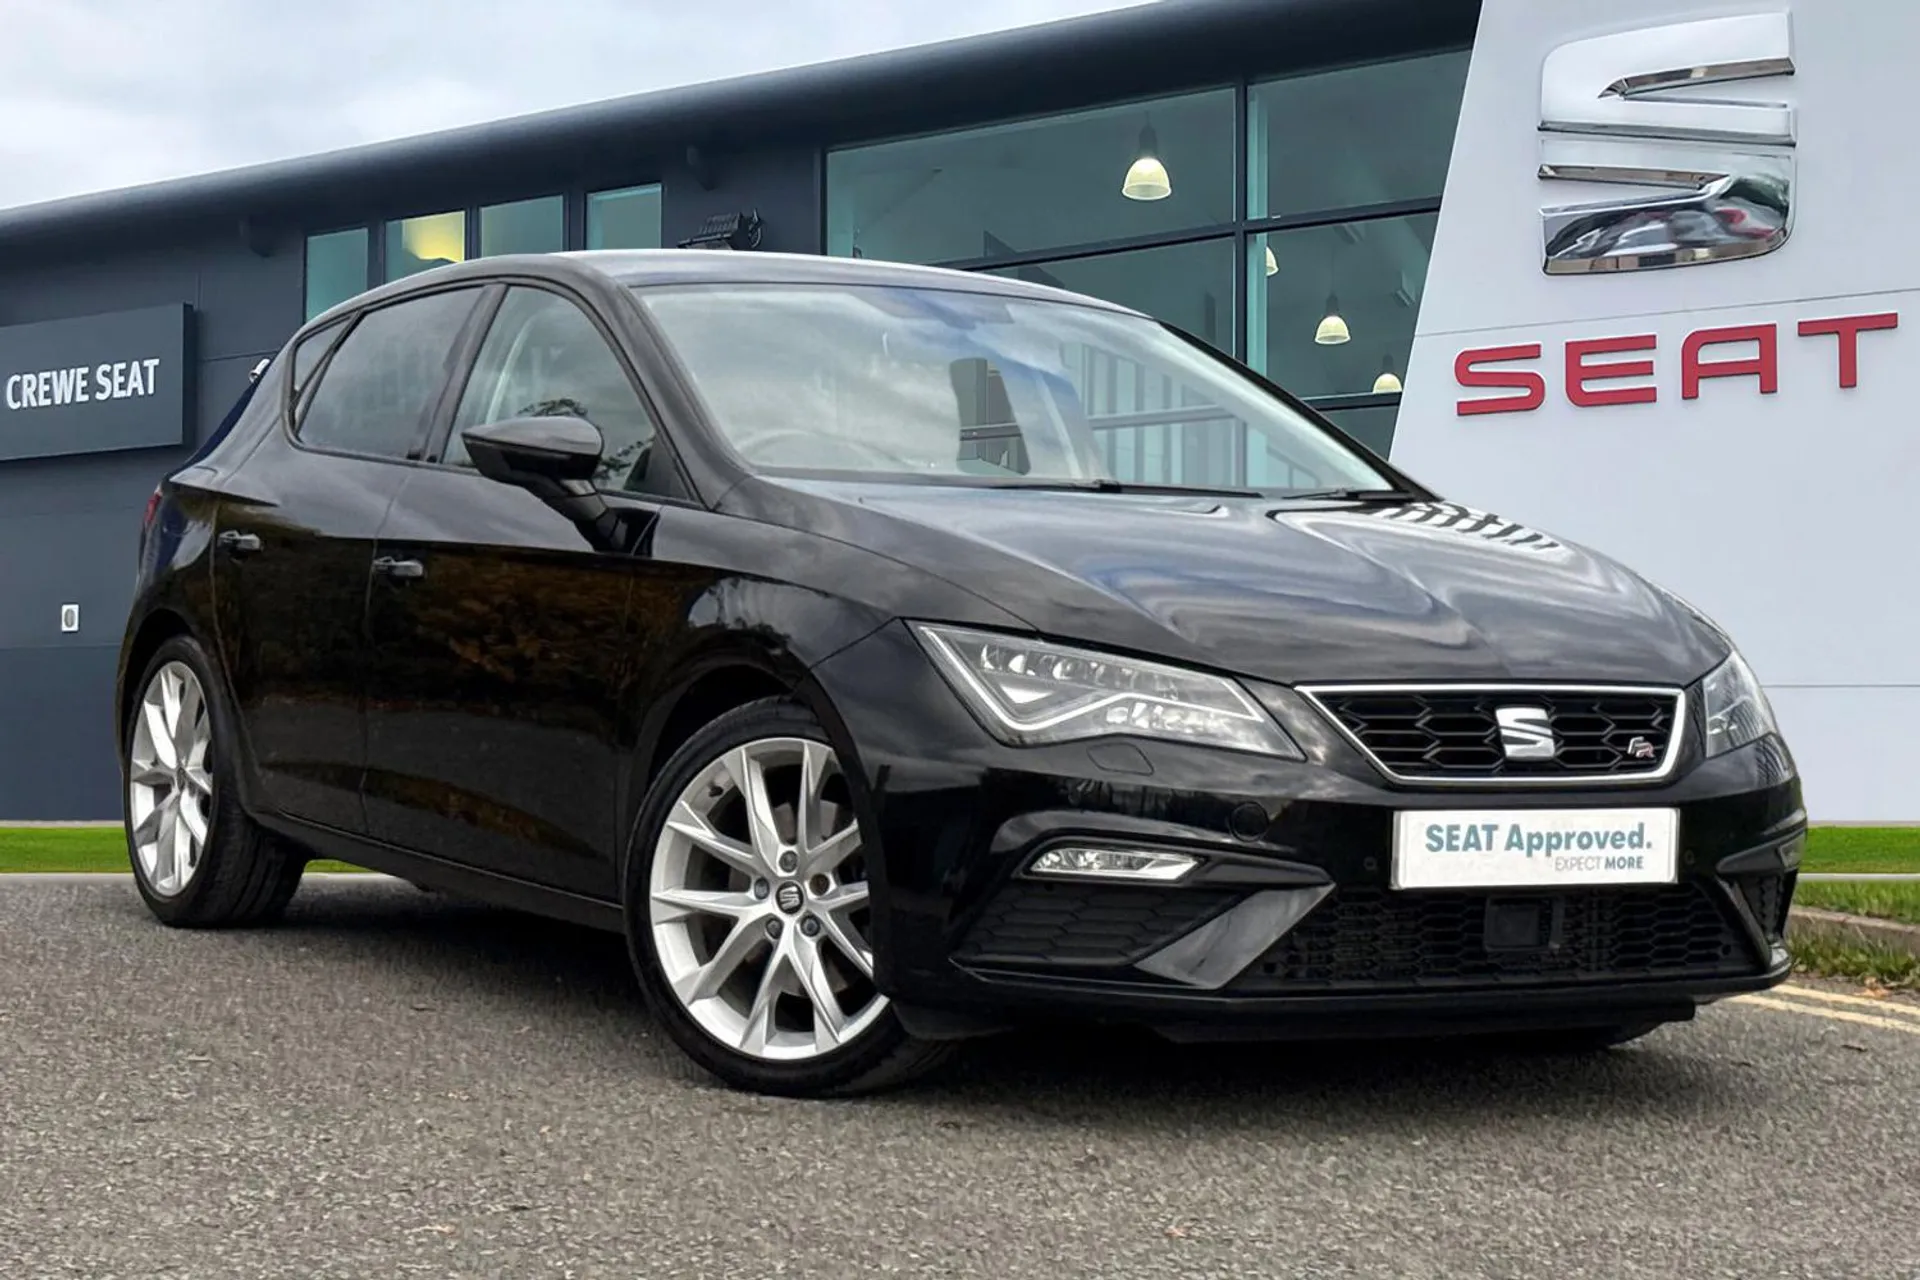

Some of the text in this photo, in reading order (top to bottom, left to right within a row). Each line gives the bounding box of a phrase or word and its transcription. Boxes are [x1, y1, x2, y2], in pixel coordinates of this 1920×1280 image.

[6, 358, 160, 410] CREWE SEAT
[1454, 312, 1899, 415] SEAT
[1425, 824, 1653, 857] SEAT Approved.
[1555, 857, 1644, 872] EXPECT MORE
